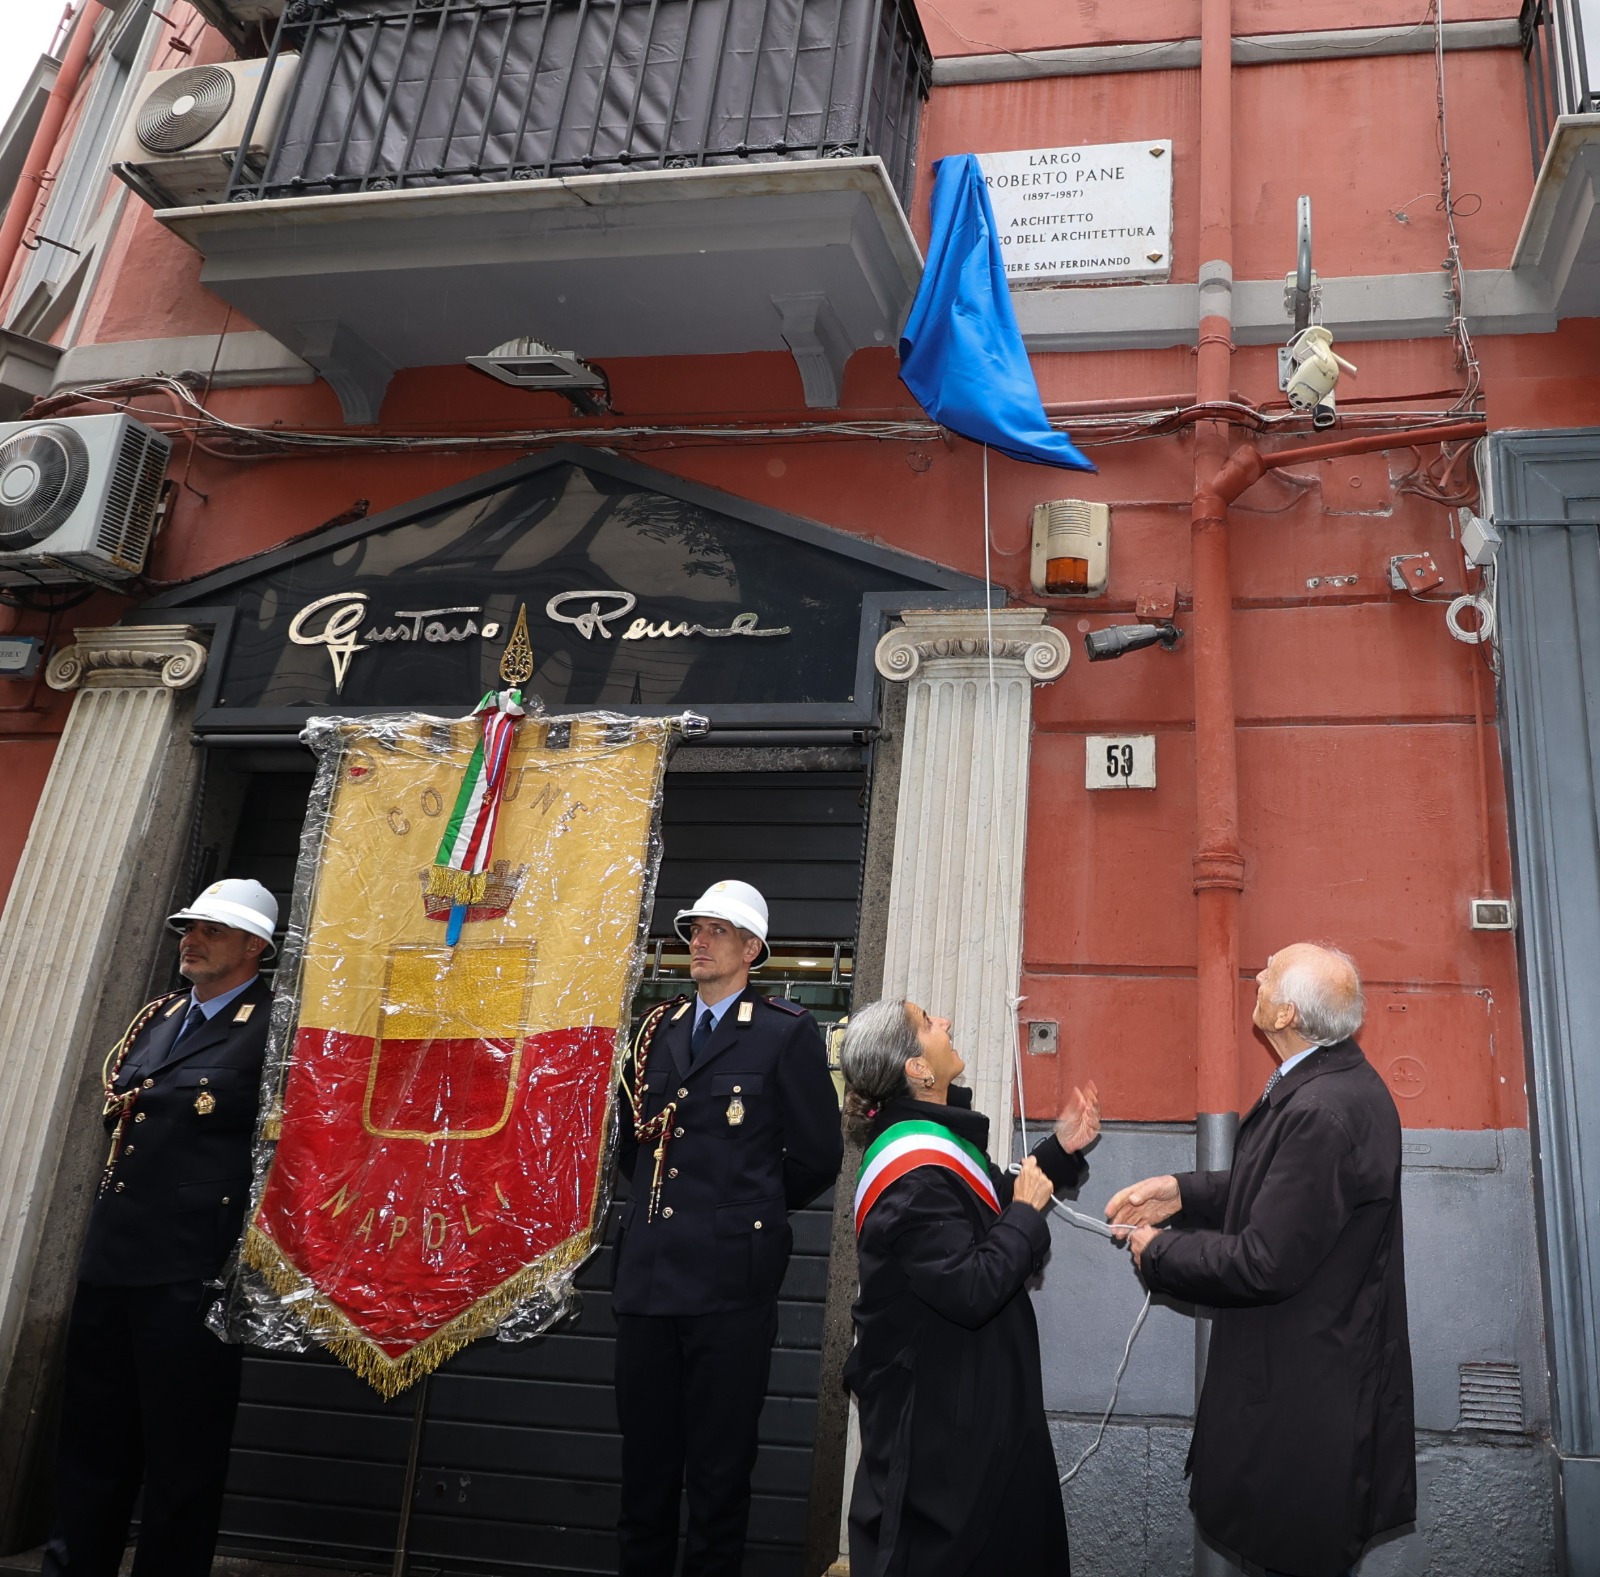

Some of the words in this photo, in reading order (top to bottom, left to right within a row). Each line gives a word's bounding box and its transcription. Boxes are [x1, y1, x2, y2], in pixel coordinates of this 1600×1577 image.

[1029, 152, 1081, 166] LARGO
[984, 171, 1068, 188] ROBERTO
[1076, 166, 1125, 182] PANE
[1022, 189, 1084, 201] (1897-1987)
[1010, 213, 1094, 227] ARCHITETTO
[1034, 261, 1057, 271] SAN
[1060, 256, 1131, 269] FERDINANDO
[387, 770, 589, 836] COUNE
[319, 1181, 511, 1250] NAPOLI
